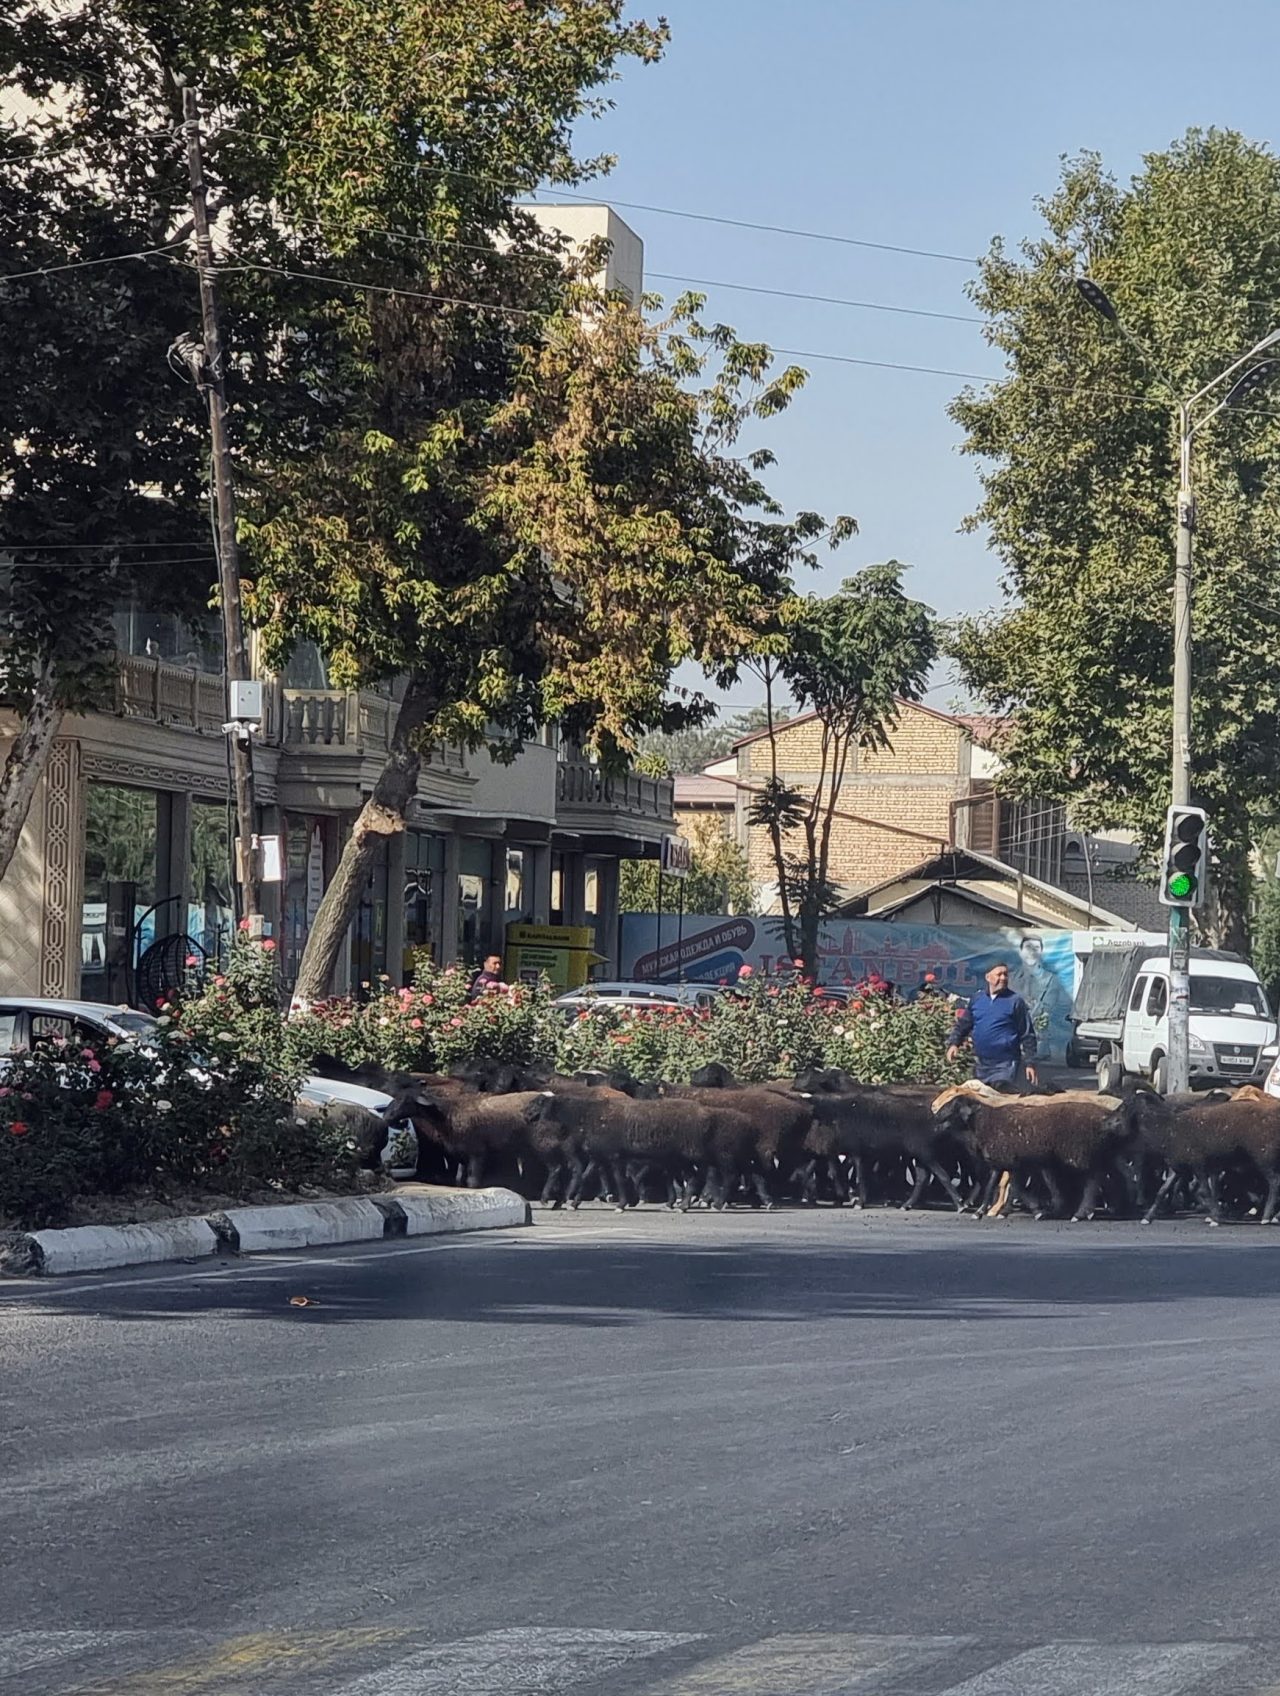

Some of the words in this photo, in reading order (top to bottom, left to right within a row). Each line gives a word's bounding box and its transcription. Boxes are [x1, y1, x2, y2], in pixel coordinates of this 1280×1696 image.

[680, 939, 714, 960] ОДЕЖДА
[714, 936, 722, 945] И
[721, 926, 748, 942] ОБУВЬ
